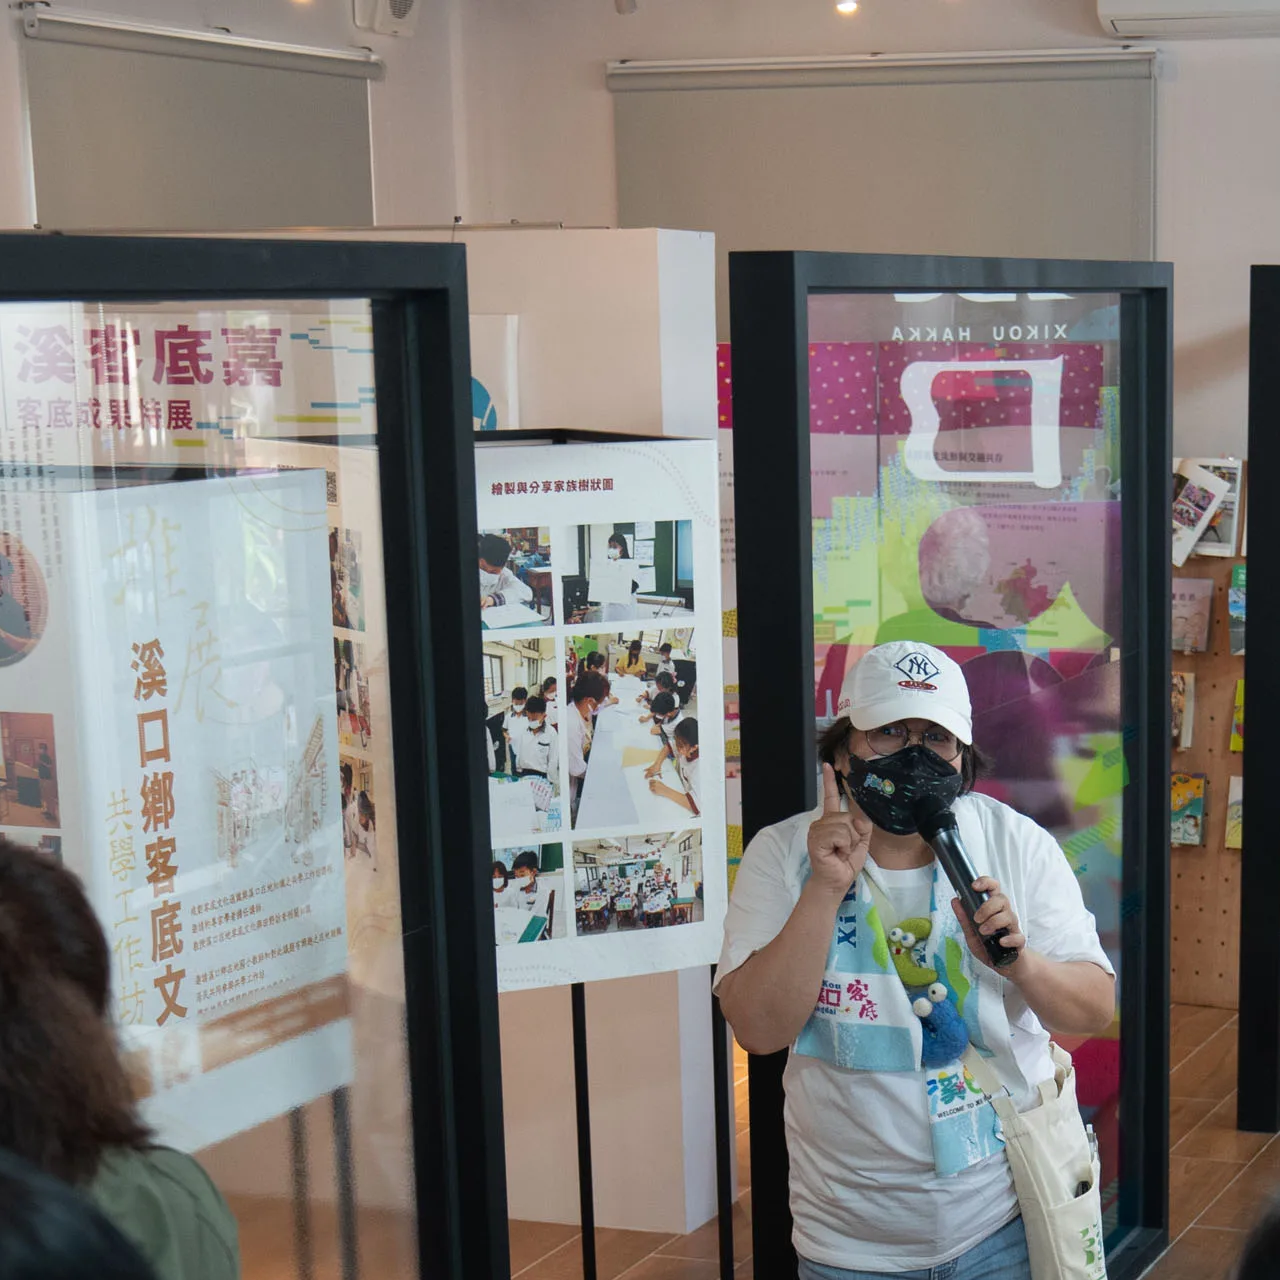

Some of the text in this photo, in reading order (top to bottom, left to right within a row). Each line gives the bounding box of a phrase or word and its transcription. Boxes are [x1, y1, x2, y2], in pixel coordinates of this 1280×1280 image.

[491, 478, 614, 496] 繪製與分享家族樹狀圖
[937, 1105, 965, 1119] WELCOME
